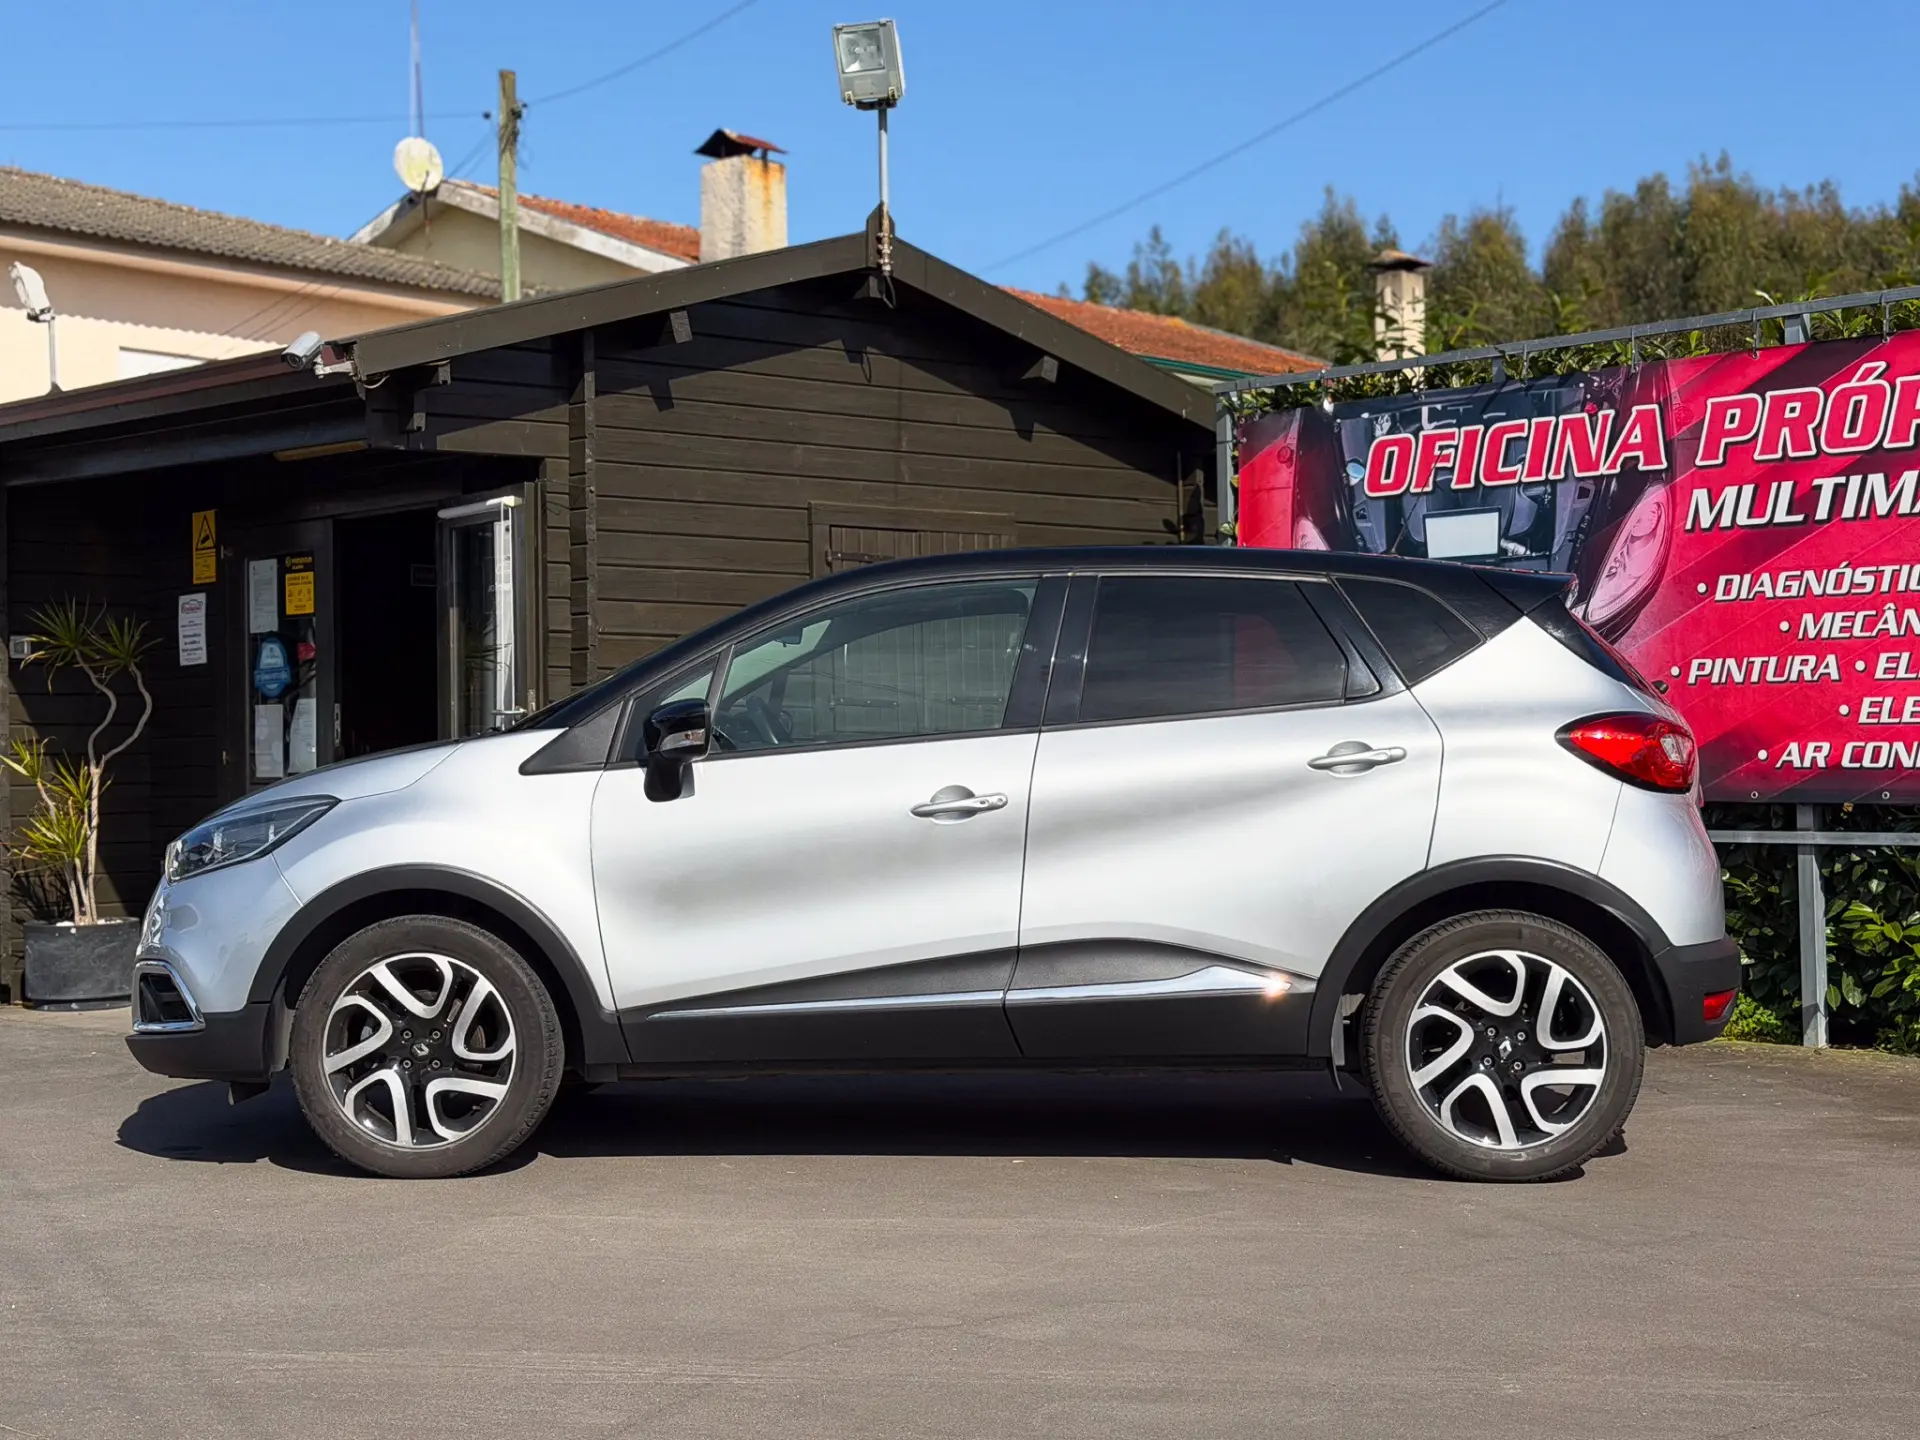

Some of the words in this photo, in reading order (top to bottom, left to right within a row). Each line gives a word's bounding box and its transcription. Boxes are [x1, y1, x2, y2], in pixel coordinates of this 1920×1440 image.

[1364, 404, 1668, 498] OFICINA
[1685, 470, 1920, 531] MULTIM
[1688, 654, 1840, 685] PINTURA
[1874, 651, 1920, 680] EL
[1858, 696, 1920, 724] ELE
[1775, 741, 1831, 769] AR
[1841, 741, 1920, 768] CON
